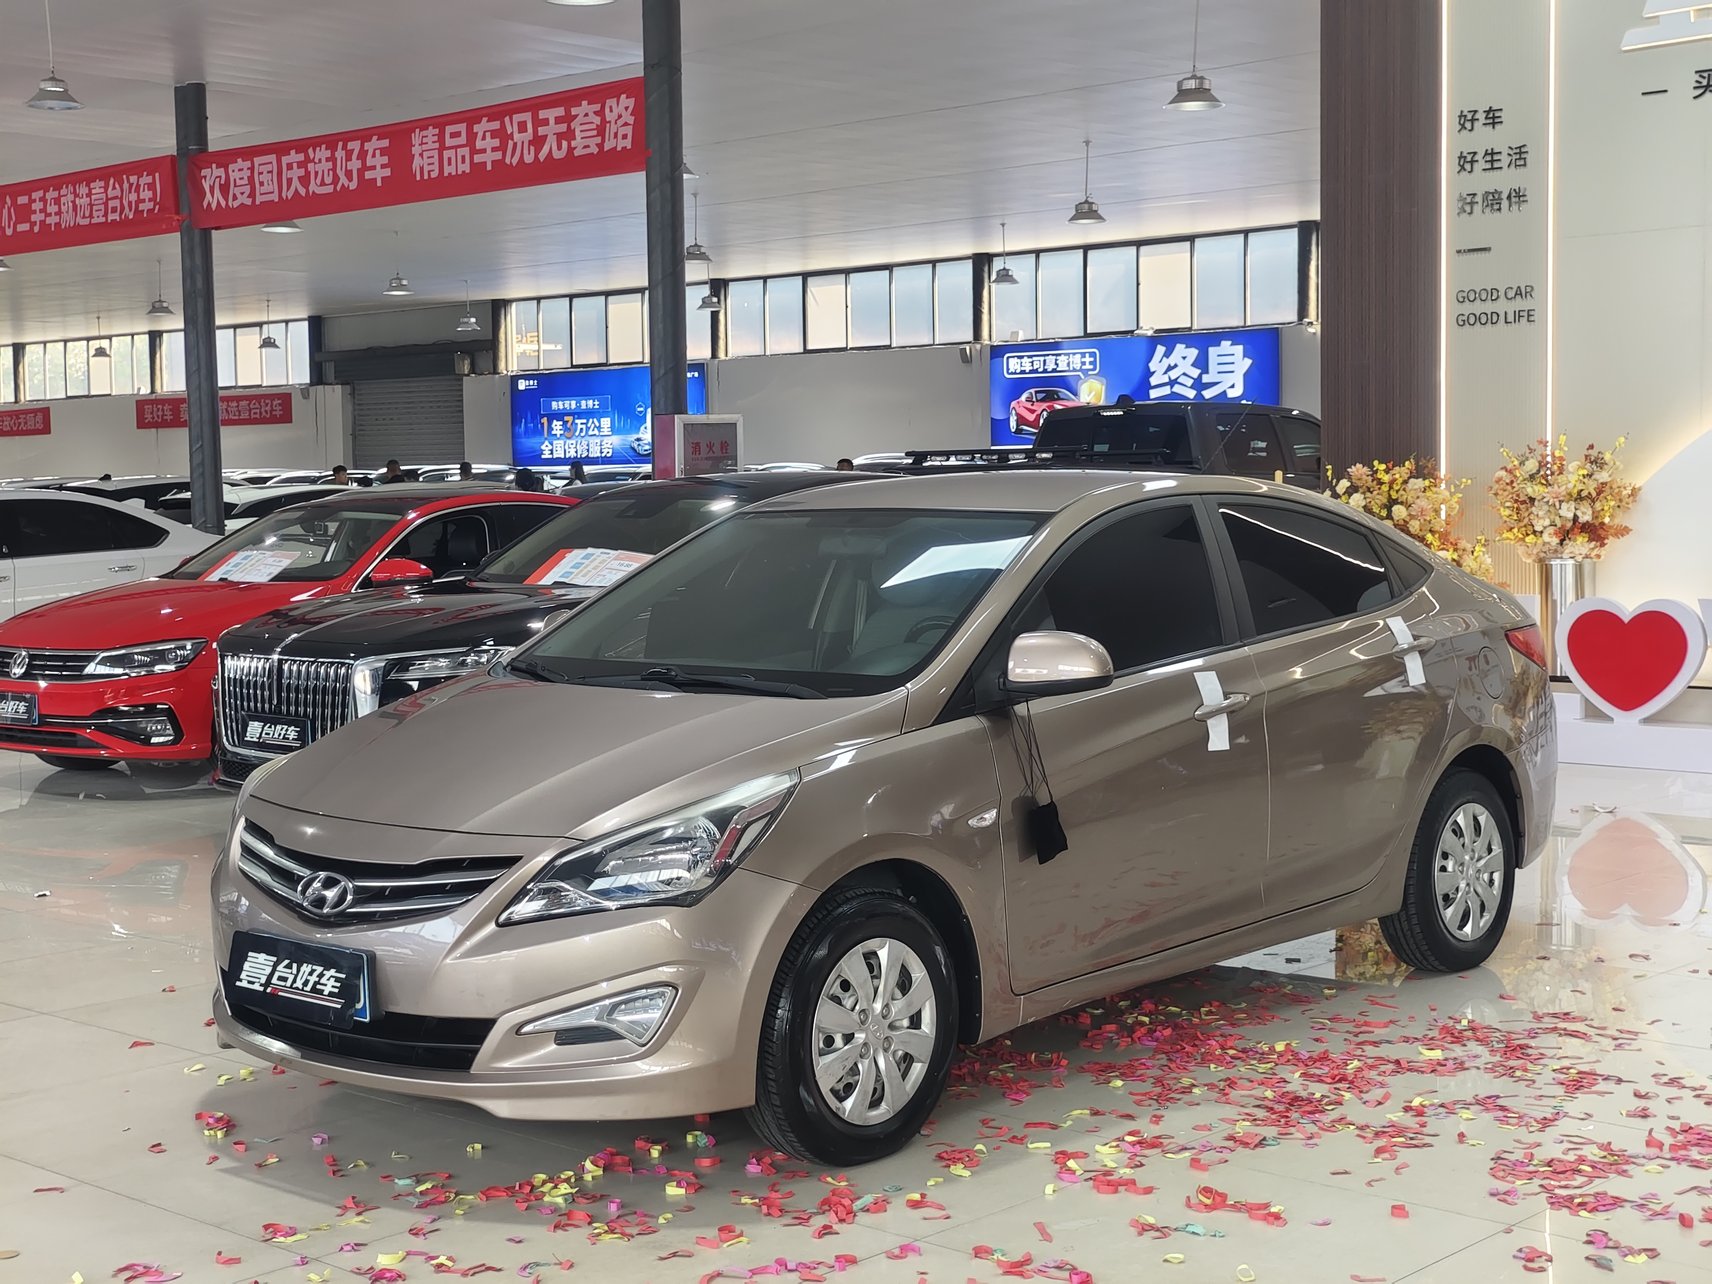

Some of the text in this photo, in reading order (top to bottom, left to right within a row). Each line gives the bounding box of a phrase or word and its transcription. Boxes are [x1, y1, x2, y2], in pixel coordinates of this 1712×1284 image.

[1457, 106, 1503, 133] 好车
[200, 94, 637, 211] 欢度国庆选好车 精品车况无套路
[1457, 144, 1529, 174] 好生活
[1457, 186, 1529, 217] 好陪伴
[1456, 284, 1534, 304] GOOD CAR
[1456, 309, 1536, 327] GOOD LIFE
[1008, 353, 1094, 373] 购车可享查博士
[1149, 340, 1253, 400] 终身
[541, 440, 613, 459] 全国保修服务
[244, 721, 301, 742] 壹台好车
[235, 951, 347, 996] 壹台好车
